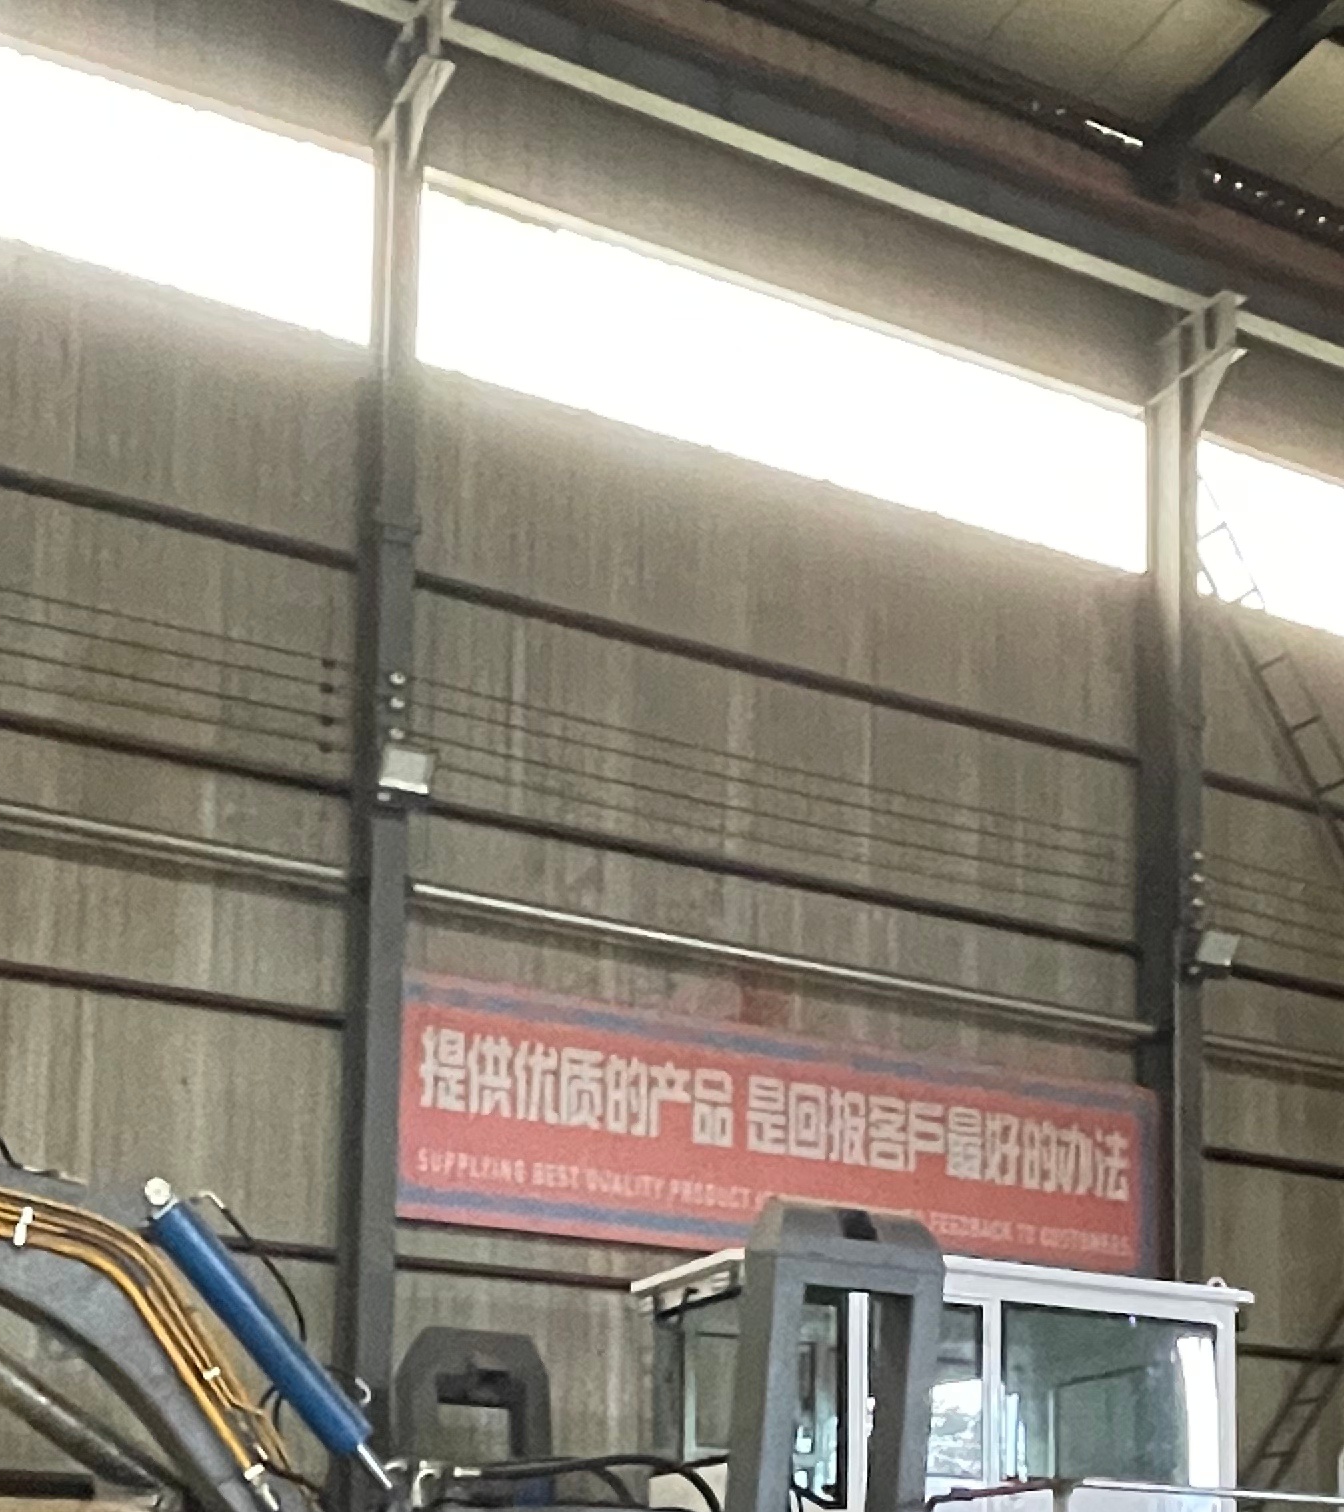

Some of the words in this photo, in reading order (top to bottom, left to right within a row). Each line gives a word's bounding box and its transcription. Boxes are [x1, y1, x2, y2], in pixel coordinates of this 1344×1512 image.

[419, 1024, 733, 1148] 提供优质的产品
[532, 1162, 580, 1190] BEST
